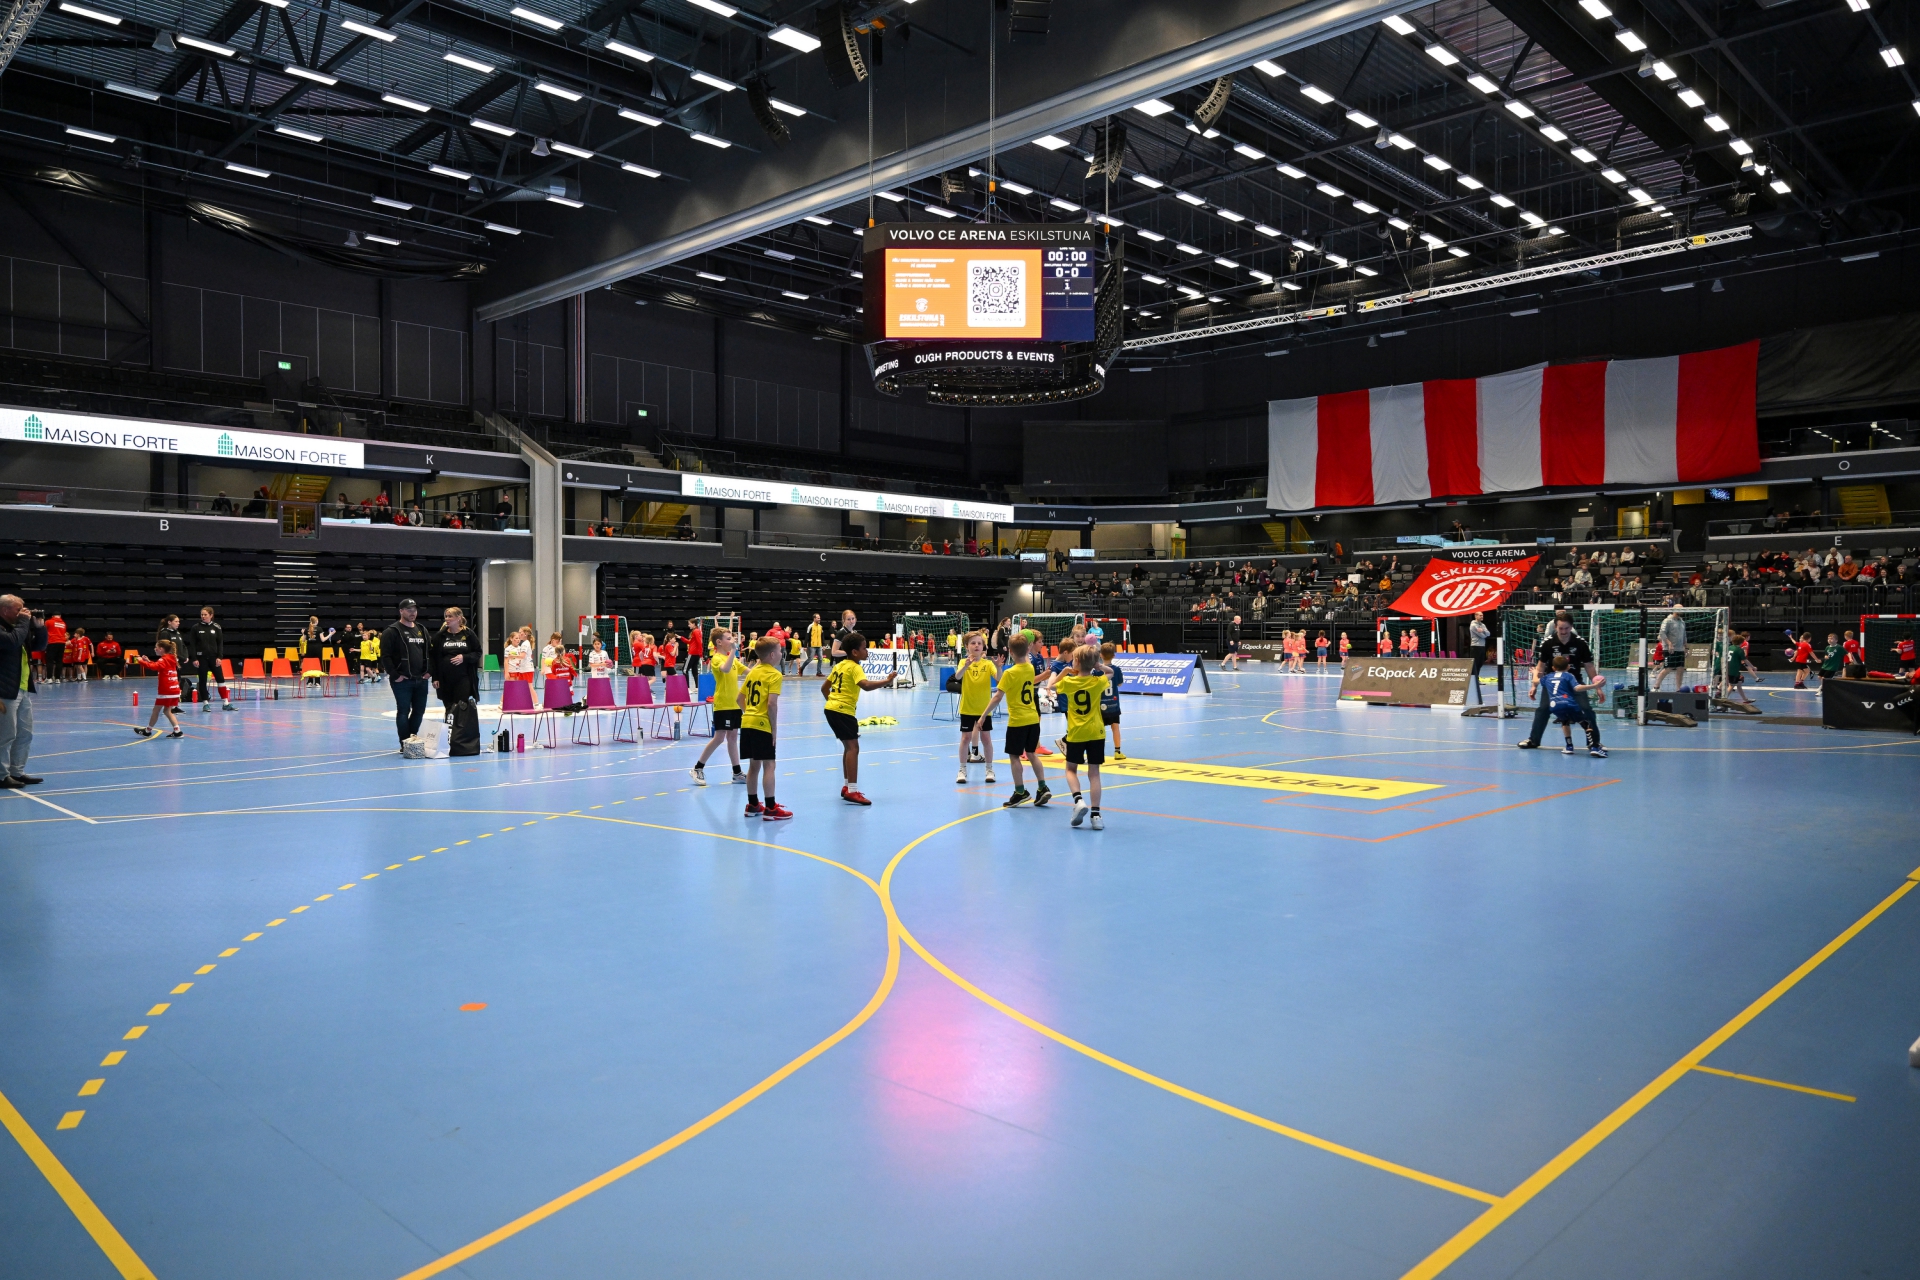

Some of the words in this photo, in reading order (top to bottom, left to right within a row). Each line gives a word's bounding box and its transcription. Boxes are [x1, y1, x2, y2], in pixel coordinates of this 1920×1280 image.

[889, 230, 934, 240] VOLVO
[938, 230, 956, 240] CE
[960, 230, 1007, 240] ARENA
[1010, 230, 1091, 240] ESKILSTUNA
[1055, 267, 1079, 278] 0-0
[1064, 282, 1071, 290] 1
[915, 353, 942, 364] OUGH
[945, 350, 1003, 361] PRODUCTS
[1006, 352, 1013, 360] &
[1017, 351, 1055, 363] EVENTS
[45, 427, 117, 446] MAISON
[123, 434, 178, 451] FORTE
[235, 444, 295, 461] MAISON
[300, 450, 347, 466] FORTE
[426, 455, 434, 465] K
[1838, 460, 1850, 471] O
[627, 473, 633, 484] L
[704, 486, 741, 498] MAISON
[743, 489, 771, 501] FORTE
[800, 494, 832, 506] MAISON
[833, 497, 859, 509] FORTE
[884, 502, 912, 513] MAISON
[914, 504, 937, 515] FORTE
[959, 508, 985, 519] MAISON
[986, 511, 1007, 521] FORTE
[1048, 510, 1056, 518] M
[1236, 505, 1243, 513] N
[160, 519, 170, 531] B
[1834, 536, 1842, 546] E
[820, 552, 827, 562] C
[1452, 550, 1480, 558] VOLVO
[1481, 550, 1494, 558] CE
[1495, 549, 1527, 557] ARENA
[1228, 560, 1235, 568] D
[1431, 566, 1519, 580] ESKILSTUNA
[1241, 643, 1262, 651] EQpack
[866, 652, 909, 663] RESTAUANT
[1367, 666, 1416, 680] EQpack
[1418, 668, 1438, 679] AB
[831, 671, 844, 694] 21
[1137, 674, 1166, 686] Flytta
[1166, 676, 1186, 688] dig!
[1551, 680, 1561, 694] 7
[746, 680, 761, 706] 16
[1021, 680, 1033, 705] 6
[1074, 690, 1092, 715] 9
[1101, 762, 1380, 792] Ramudden
